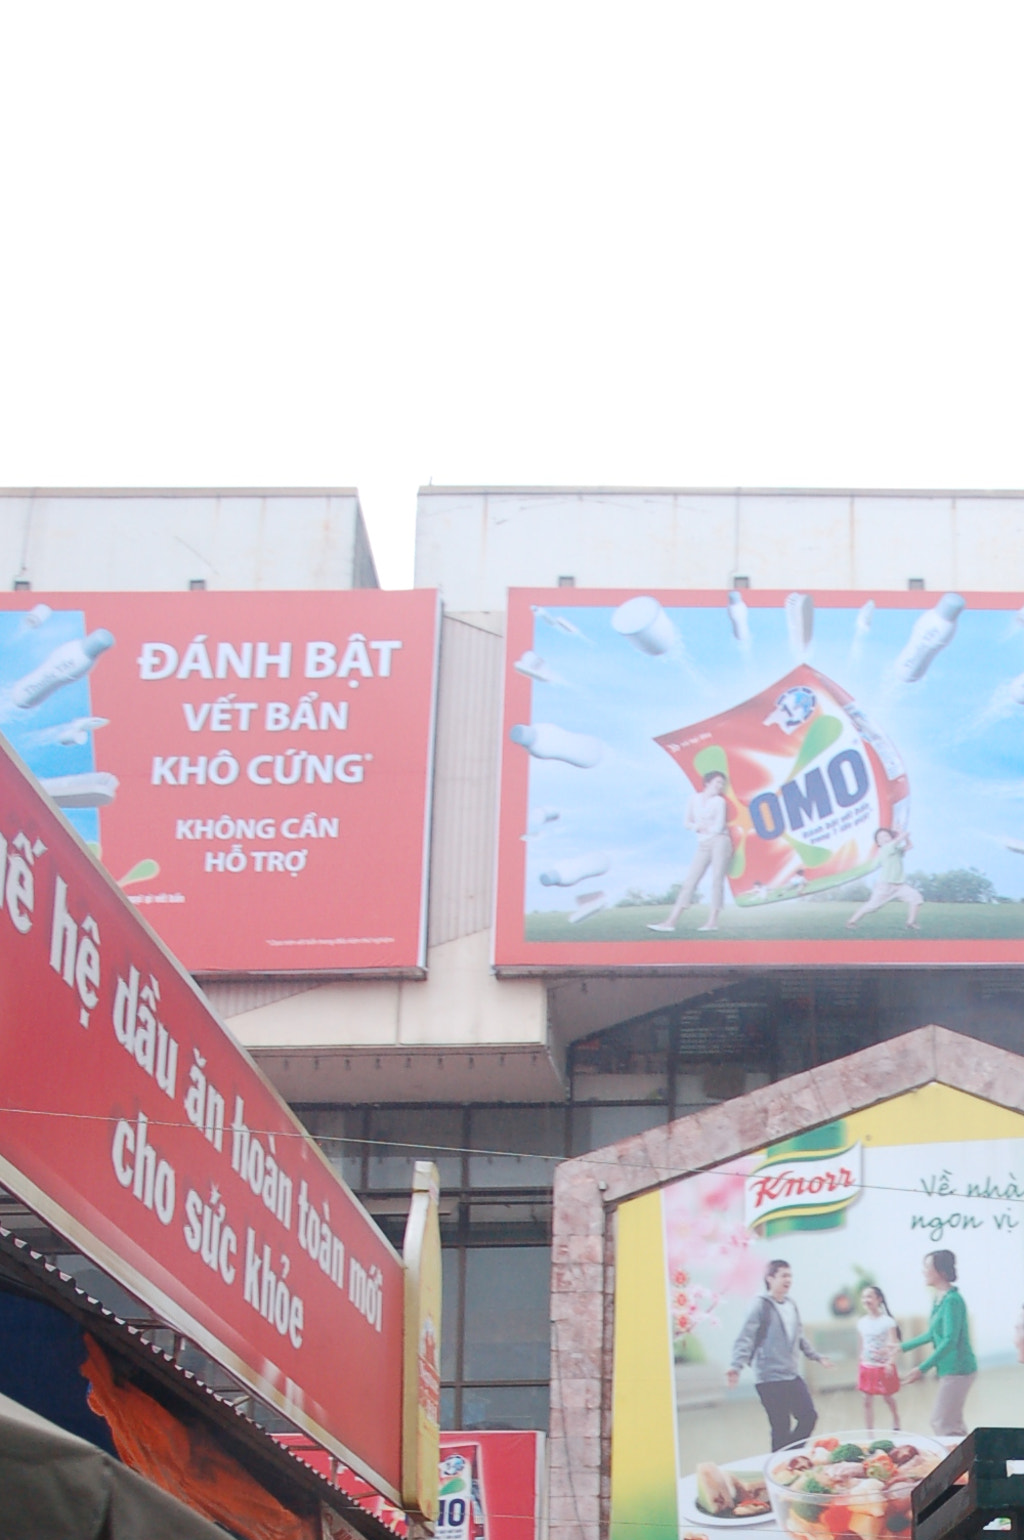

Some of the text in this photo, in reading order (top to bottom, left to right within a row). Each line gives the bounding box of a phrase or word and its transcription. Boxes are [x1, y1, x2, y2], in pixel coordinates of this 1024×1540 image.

[137, 632, 402, 688] ĐÁNH BẬT
[183, 691, 349, 732] VẾT BẨN
[151, 750, 240, 786] KHÔ
[748, 749, 871, 841] OMO
[175, 812, 340, 841] KHÔNG CẦN
[204, 845, 308, 877] HỖ TRỢ
[50, 874, 101, 1029] hệ
[112, 964, 179, 1099] dầu
[183, 1047, 225, 1153] ăn
[231, 1095, 293, 1230] hoàn
[298, 1184, 345, 1290] toàn
[349, 1255, 384, 1333] mới
[749, 1166, 856, 1209] Knorr
[919, 1170, 956, 1198] Về
[112, 1112, 304, 1350] cho sức khỏe
[910, 1212, 984, 1242] ngon
[993, 1213, 1020, 1234] vị
